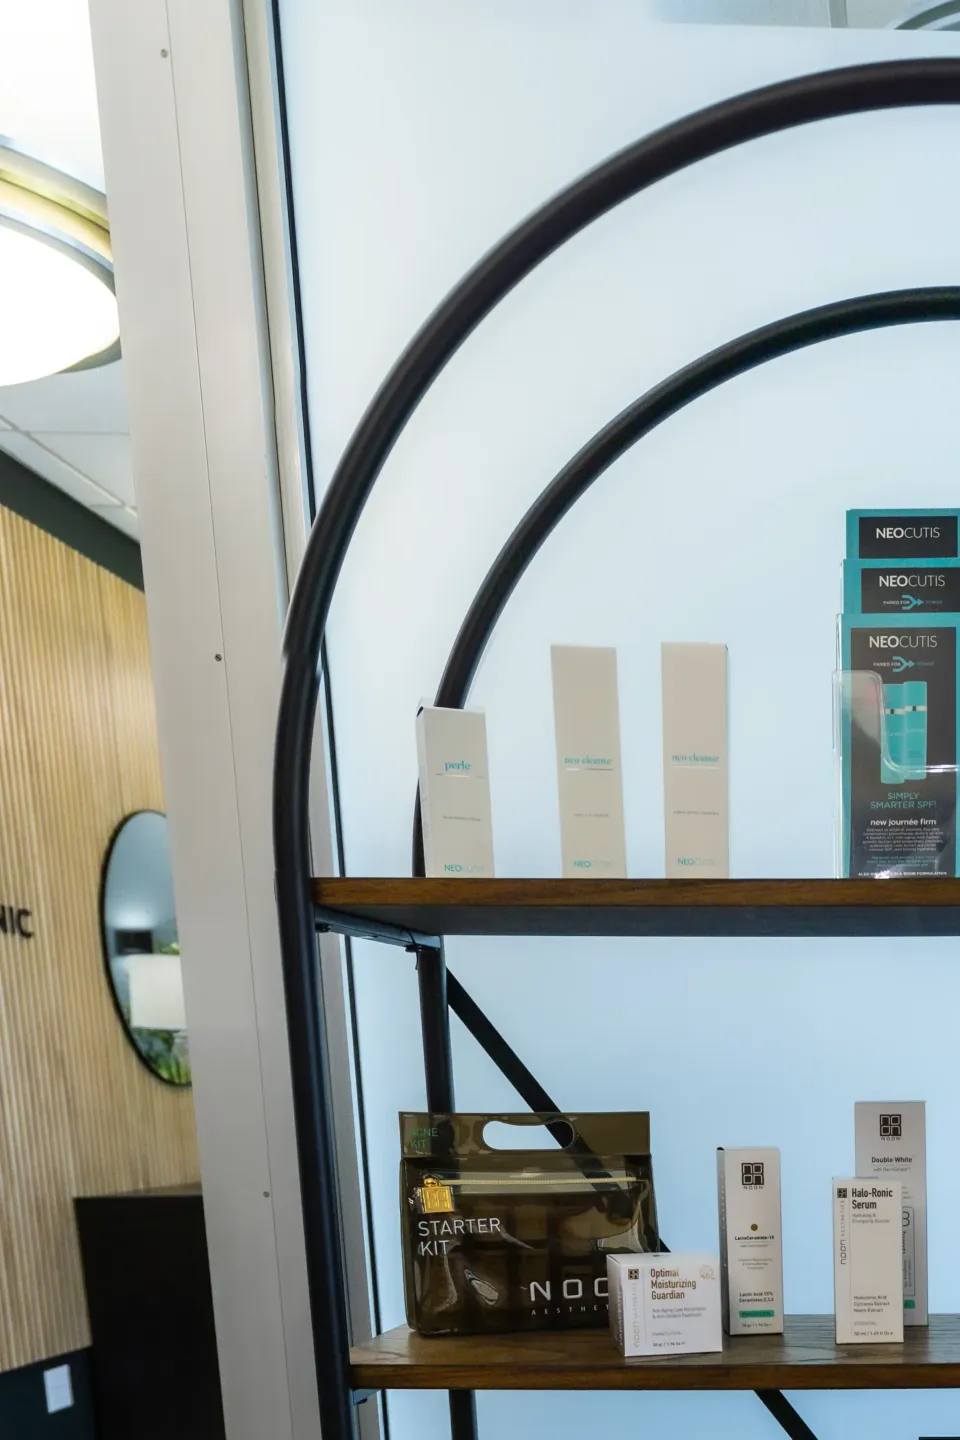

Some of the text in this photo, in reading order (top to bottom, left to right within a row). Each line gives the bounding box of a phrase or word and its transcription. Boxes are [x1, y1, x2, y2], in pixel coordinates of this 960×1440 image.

[876, 527, 940, 538] NEOCUTIS
[879, 575, 946, 587] NEOCUTIS
[869, 635, 938, 648] NEOCUTIS
[582, 755, 612, 765] cleanse
[689, 753, 719, 763] cleanse
[444, 761, 472, 772] perle
[887, 792, 919, 800] SIMPLY
[410, 1140, 426, 1149] KIT
[851, 1188, 893, 1198] Halo-Ronic
[852, 1200, 877, 1209] Serum
[418, 1218, 501, 1236] STARTER
[421, 1240, 449, 1256] KIT
[650, 1268, 679, 1279] Optimal
[651, 1279, 696, 1290] Moisturizing
[652, 1290, 685, 1300] Guardian
